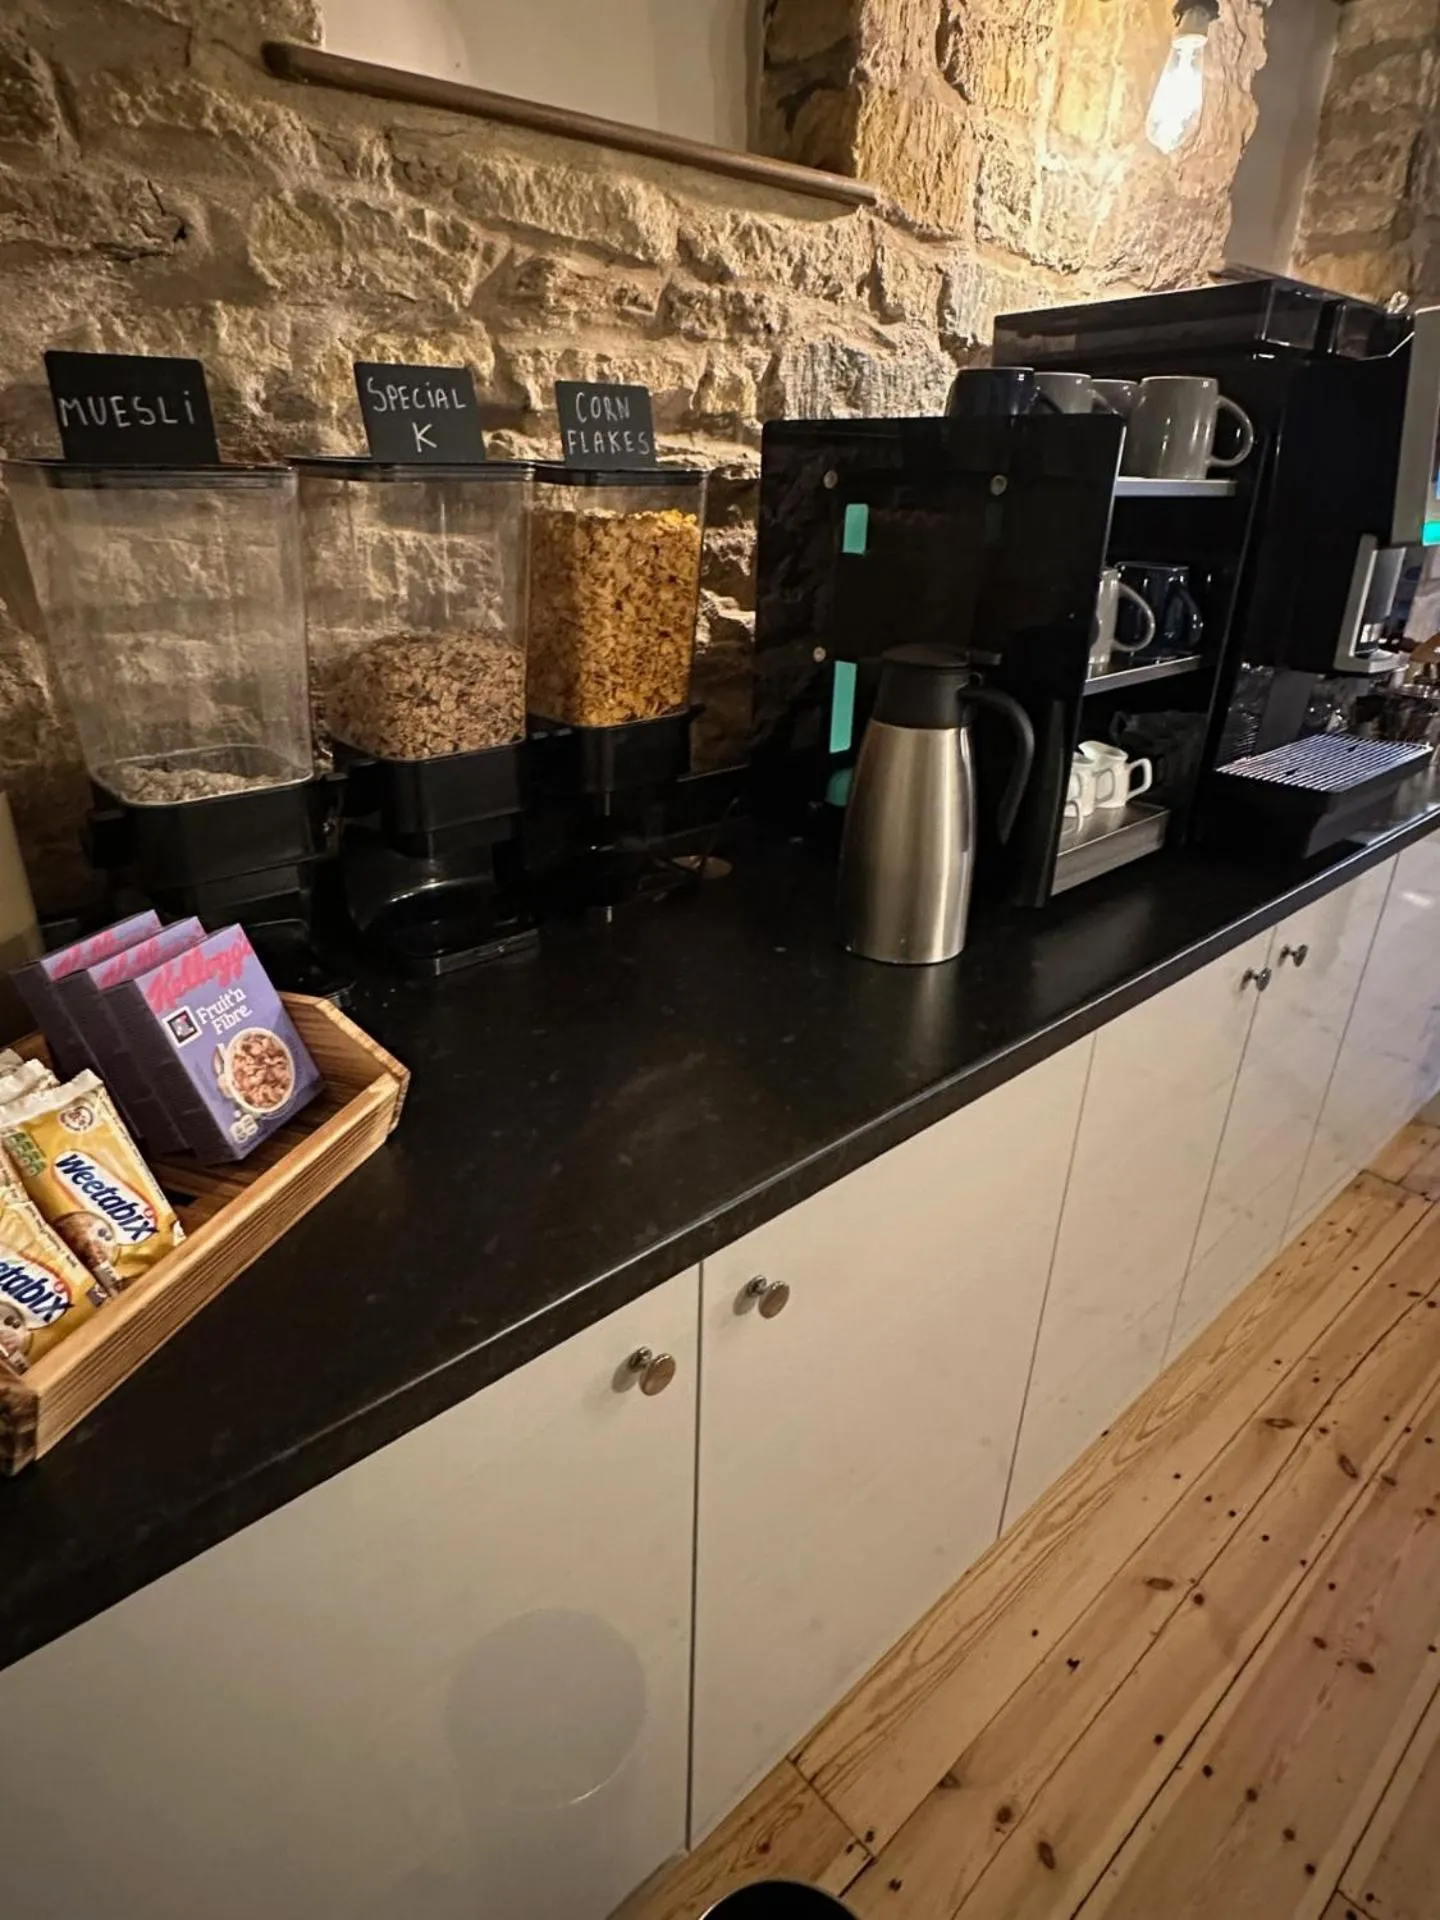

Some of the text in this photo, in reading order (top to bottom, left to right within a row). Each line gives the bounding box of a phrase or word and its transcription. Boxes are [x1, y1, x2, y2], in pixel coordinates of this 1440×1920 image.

[575, 391, 630, 423] CORN
[411, 422, 437, 452] K
[567, 429, 650, 455] FLAKES
[55, 1153, 158, 1241] Weetabix
